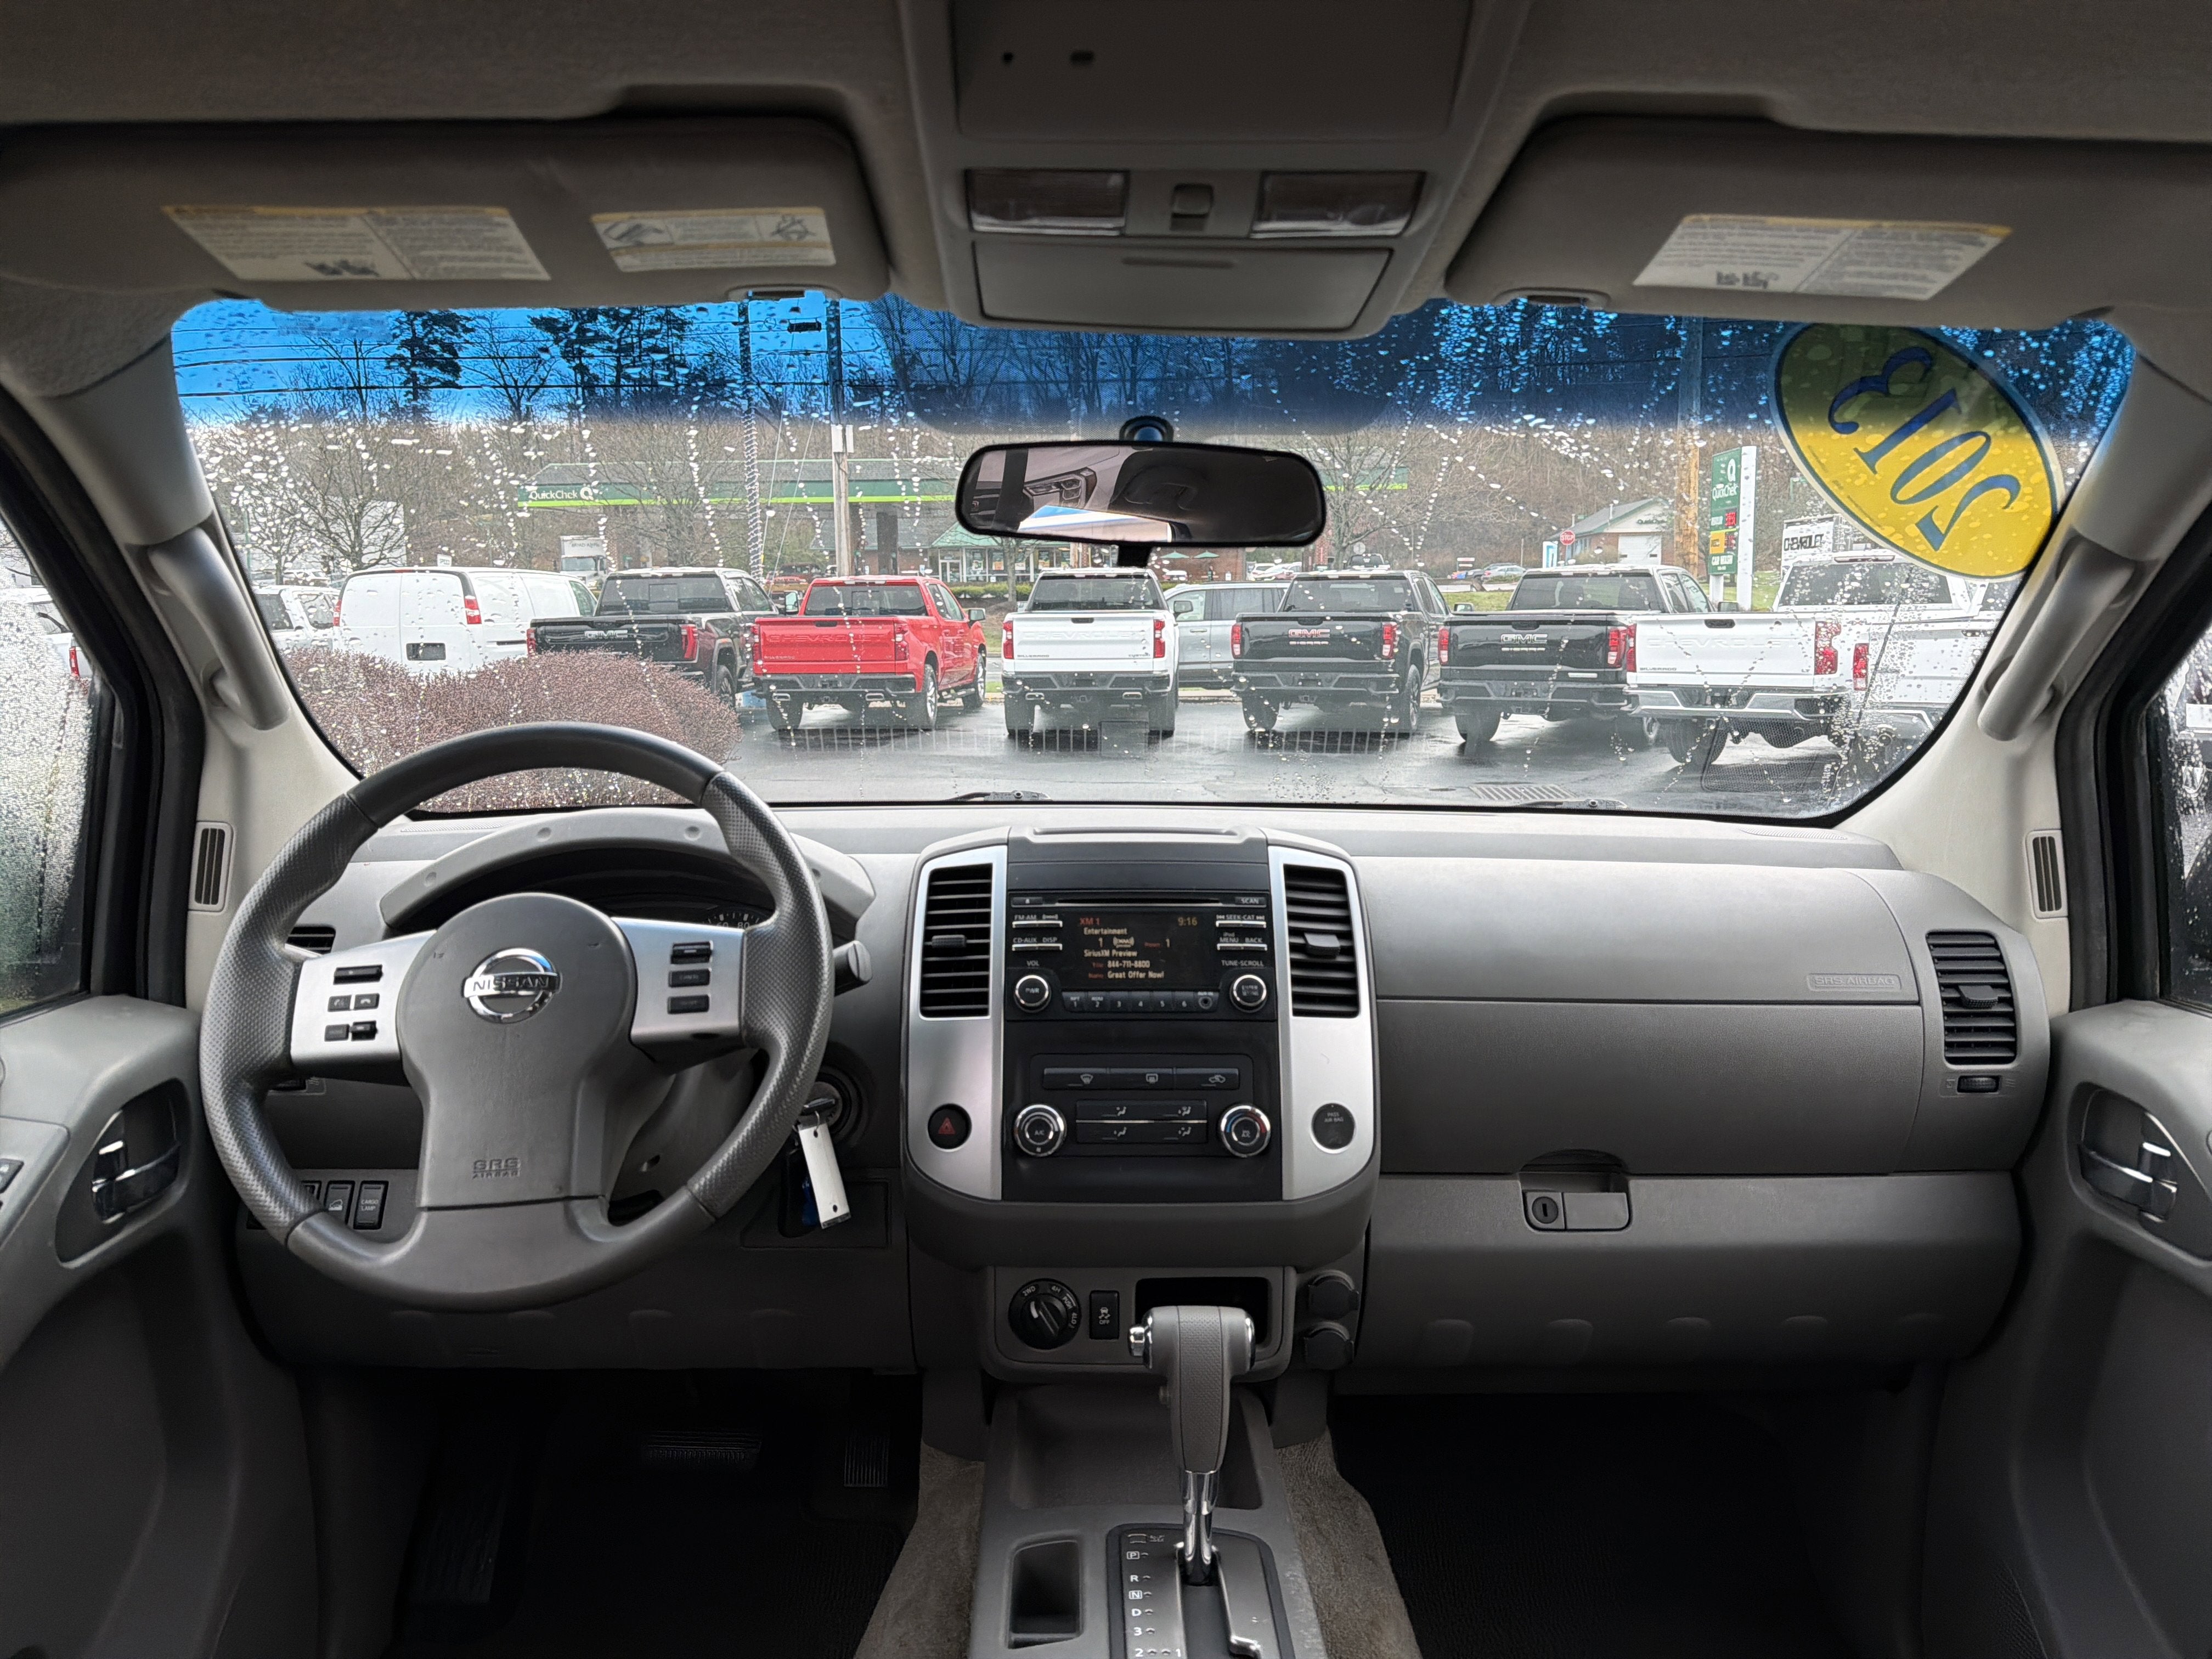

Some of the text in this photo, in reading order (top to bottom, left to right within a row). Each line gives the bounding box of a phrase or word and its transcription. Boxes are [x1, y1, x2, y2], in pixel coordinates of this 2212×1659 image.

[528, 489, 578, 501] QuickChek
[584, 629, 628, 639] GMC
[1288, 629, 1330, 639] GMC
[1500, 634, 1548, 644] GMC
[1177, 917, 1198, 927] 9:16
[1084, 949, 1138, 957] SiriusXM Preview
[1107, 970, 1126, 979] Great
[1128, 970, 1146, 979] Offer
[473, 975, 549, 991] NISSAN
[1814, 975, 1895, 986] SRS AIRBAG
[473, 1158, 520, 1172] SRS
[1022, 1285, 1036, 1296] 2WD
[1051, 1285, 1062, 1293] 4H
[1133, 1627, 1142, 1636] 3
[1135, 1648, 1181, 1657] 2 1
